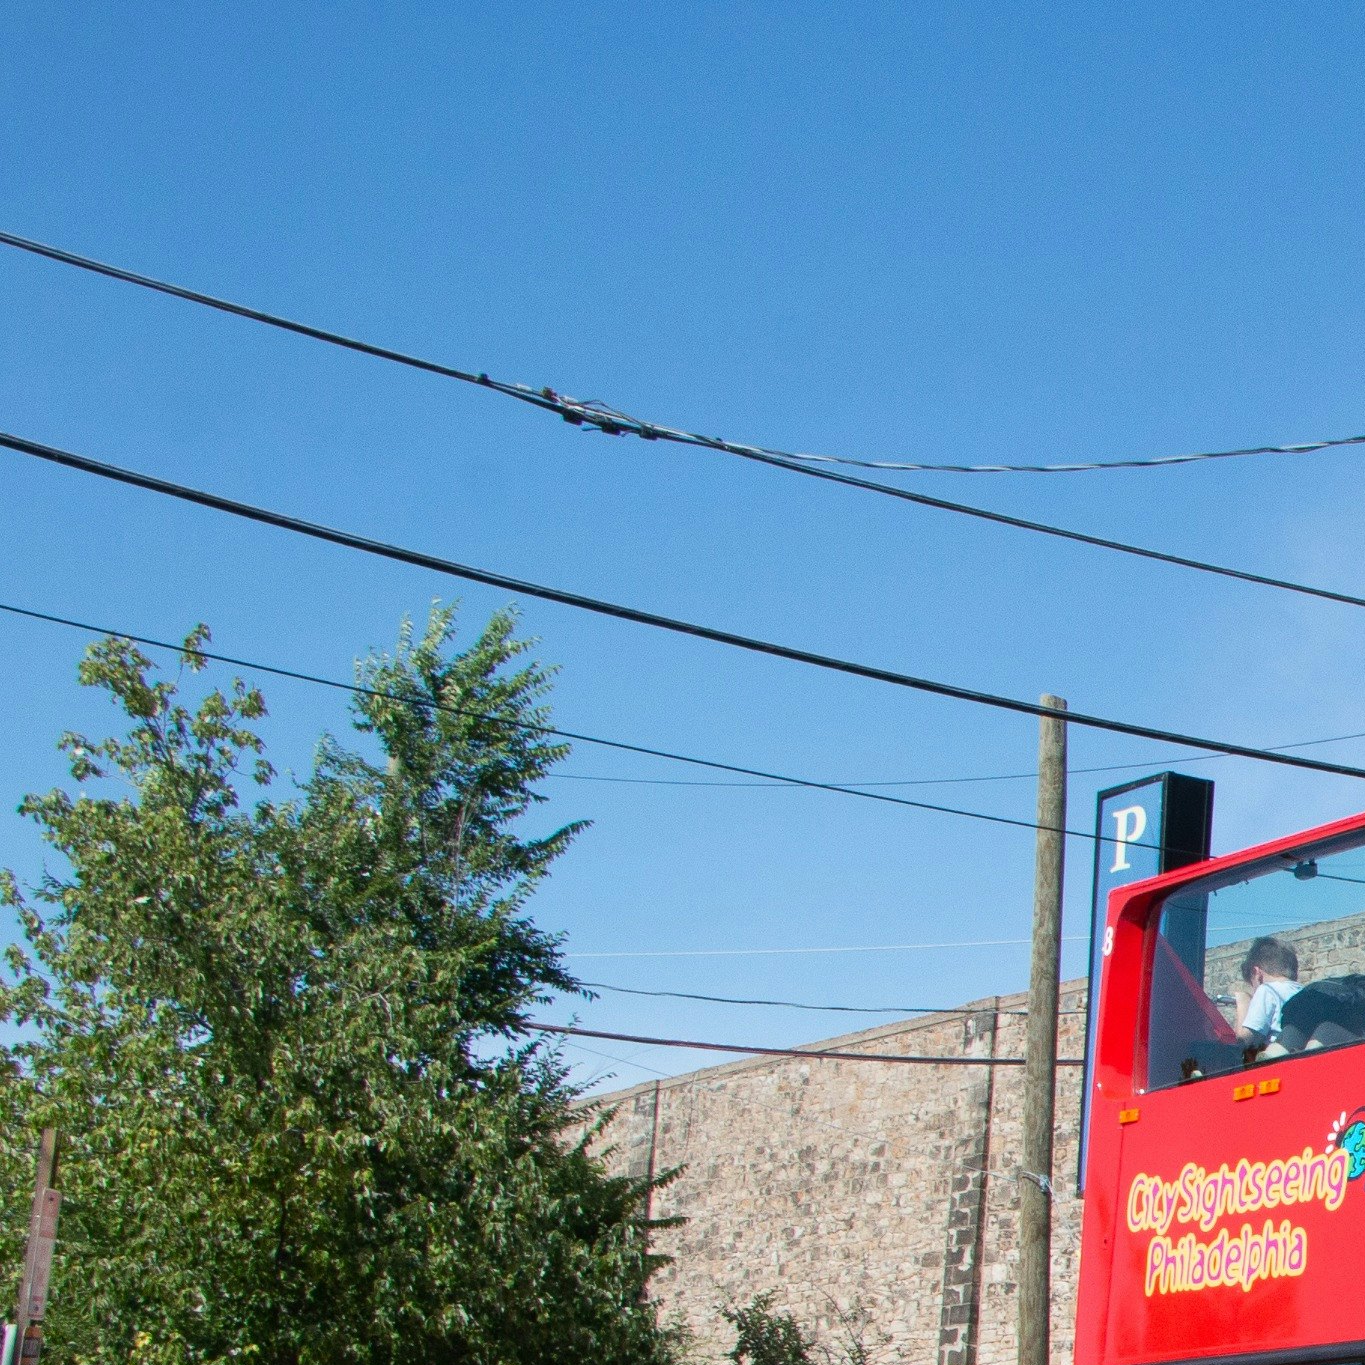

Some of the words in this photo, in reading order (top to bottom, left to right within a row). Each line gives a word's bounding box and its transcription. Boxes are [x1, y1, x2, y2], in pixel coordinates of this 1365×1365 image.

[1111, 805, 1147, 873] P
[1127, 1147, 1350, 1235] CitySightseeing
[1145, 1220, 1307, 1297] Philadelphia
